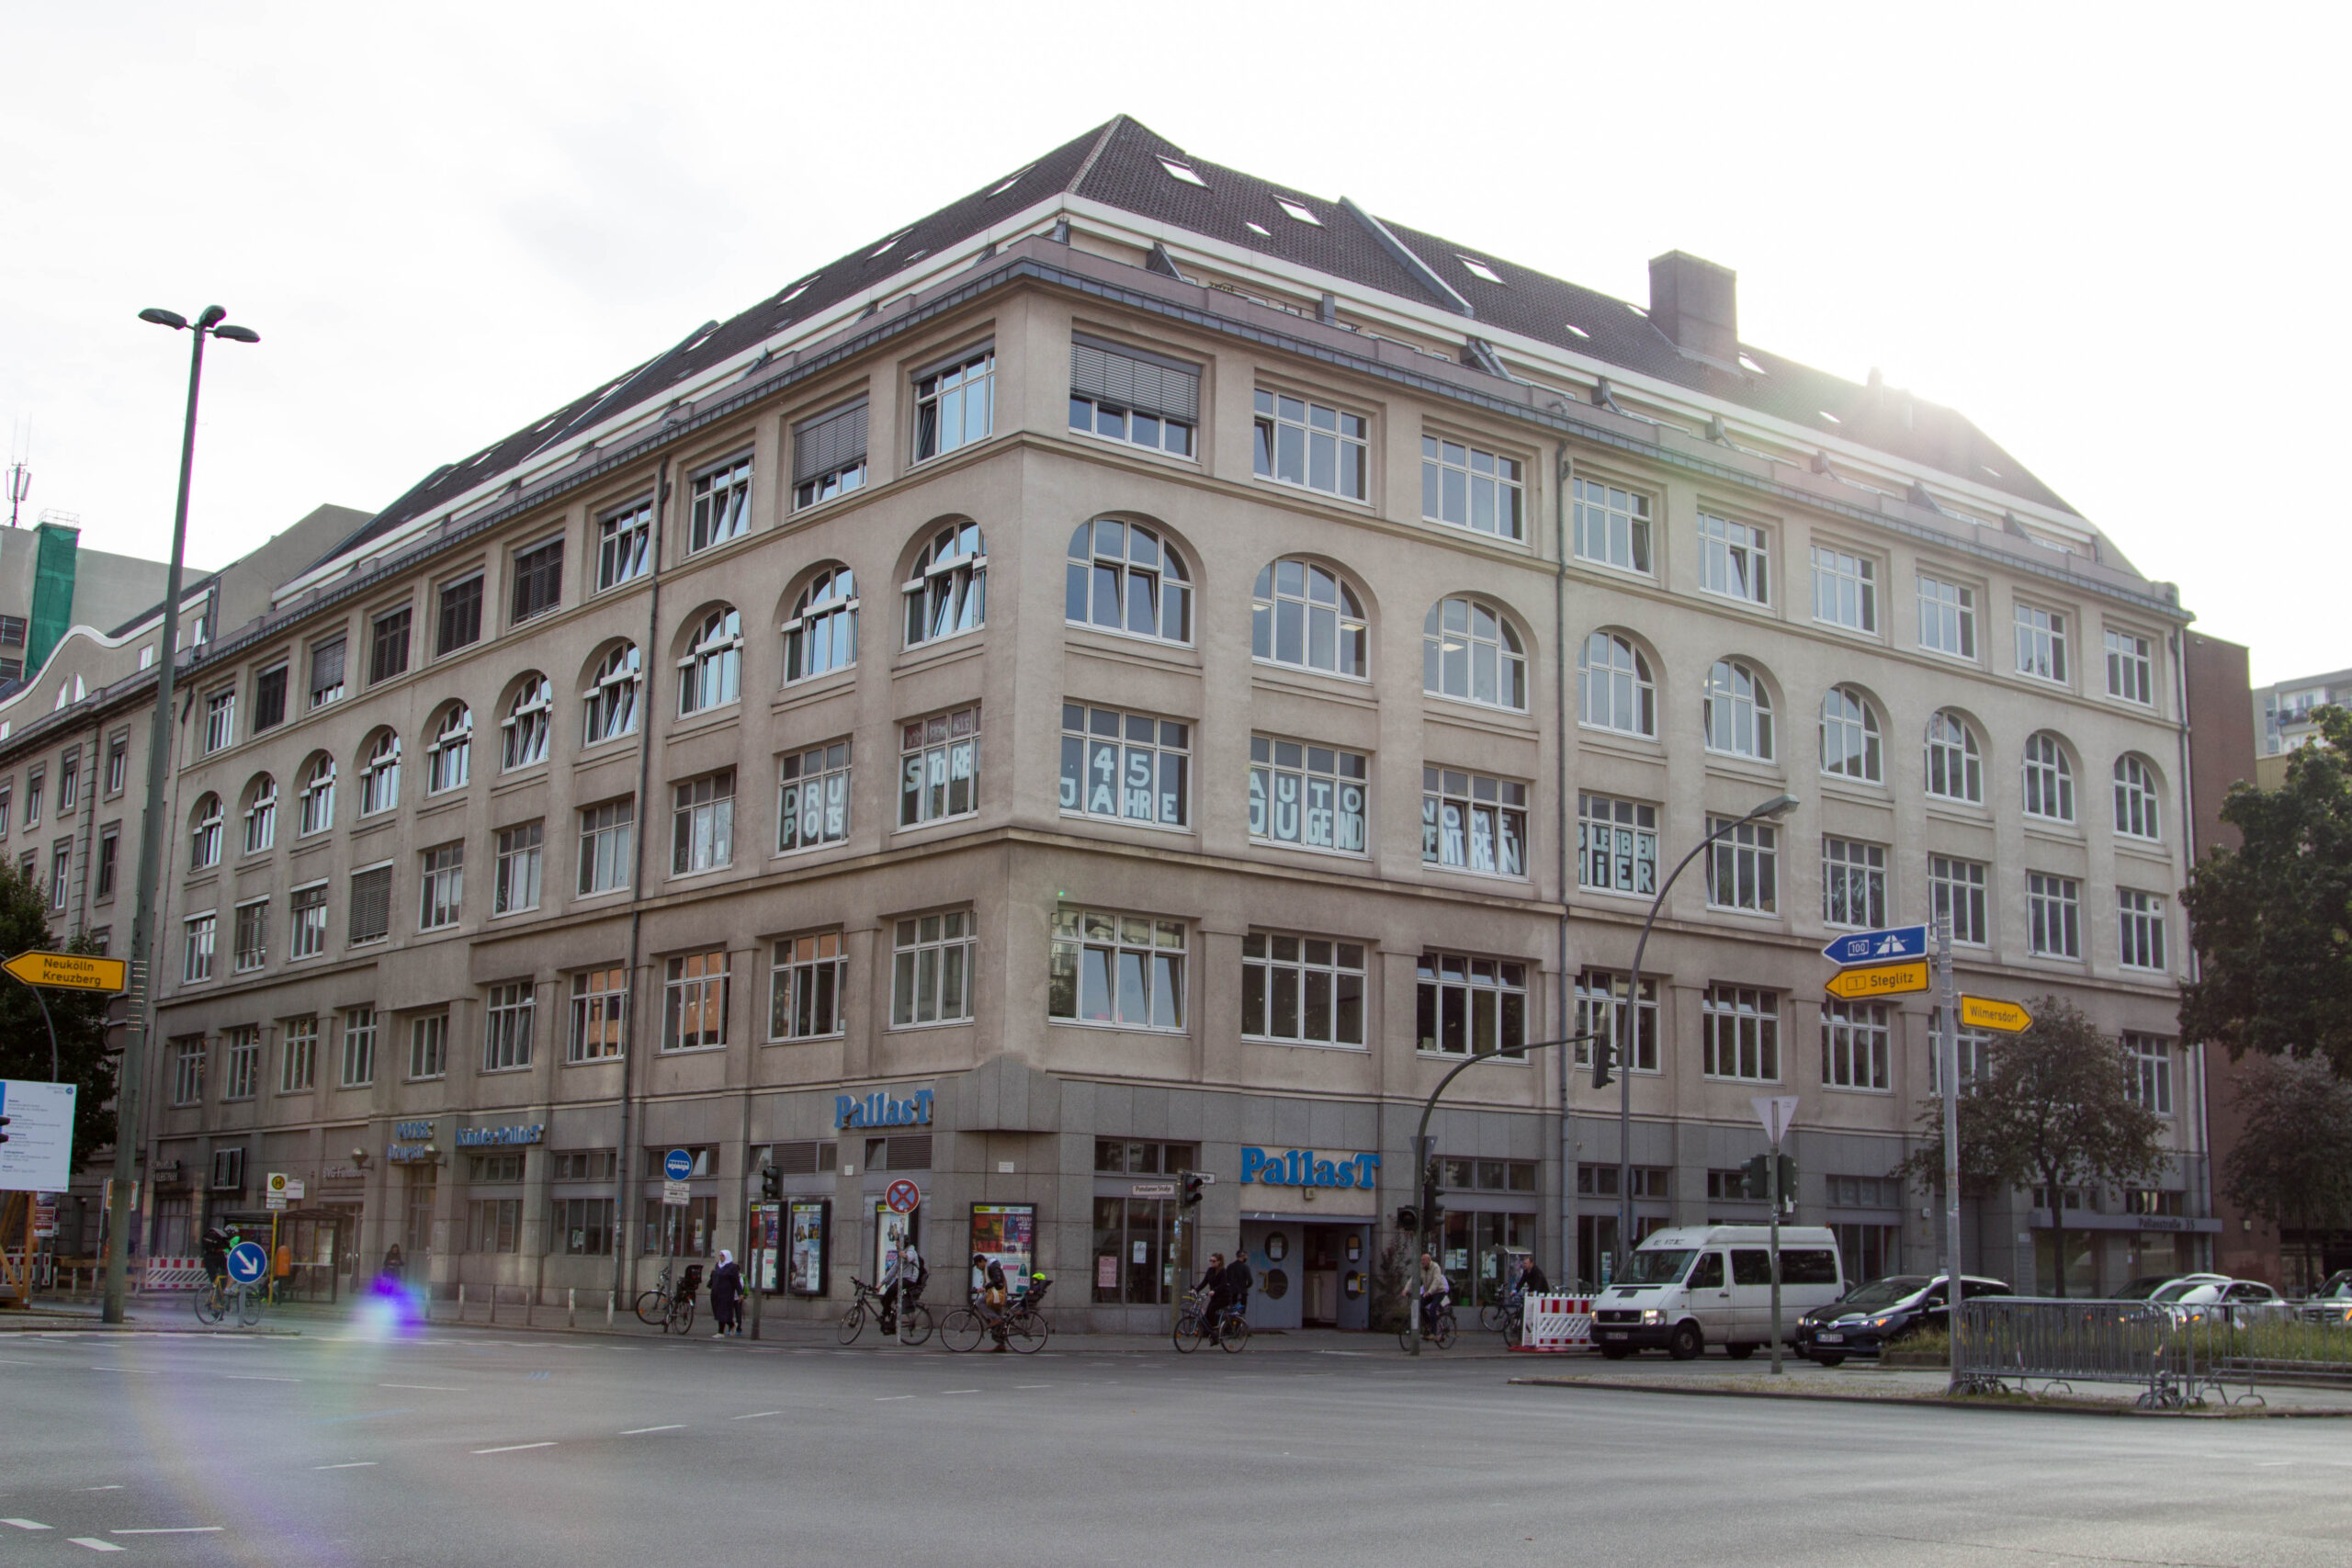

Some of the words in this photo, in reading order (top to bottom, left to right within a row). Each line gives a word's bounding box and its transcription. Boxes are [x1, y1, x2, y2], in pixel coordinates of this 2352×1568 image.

[905, 745, 971, 794] STORE
[1093, 746, 1150, 788] 45
[1060, 776, 1178, 822] JAHRE
[1250, 771, 1363, 813] AUTO
[1250, 797, 1364, 851] JUGEND
[1851, 942, 1866, 953] 100
[42, 970, 102, 987] Kreuzberg
[43, 958, 95, 972] Neukölln
[1870, 972, 1915, 989] Steglitz
[1969, 1005, 2019, 1023] Wilmersdorf
